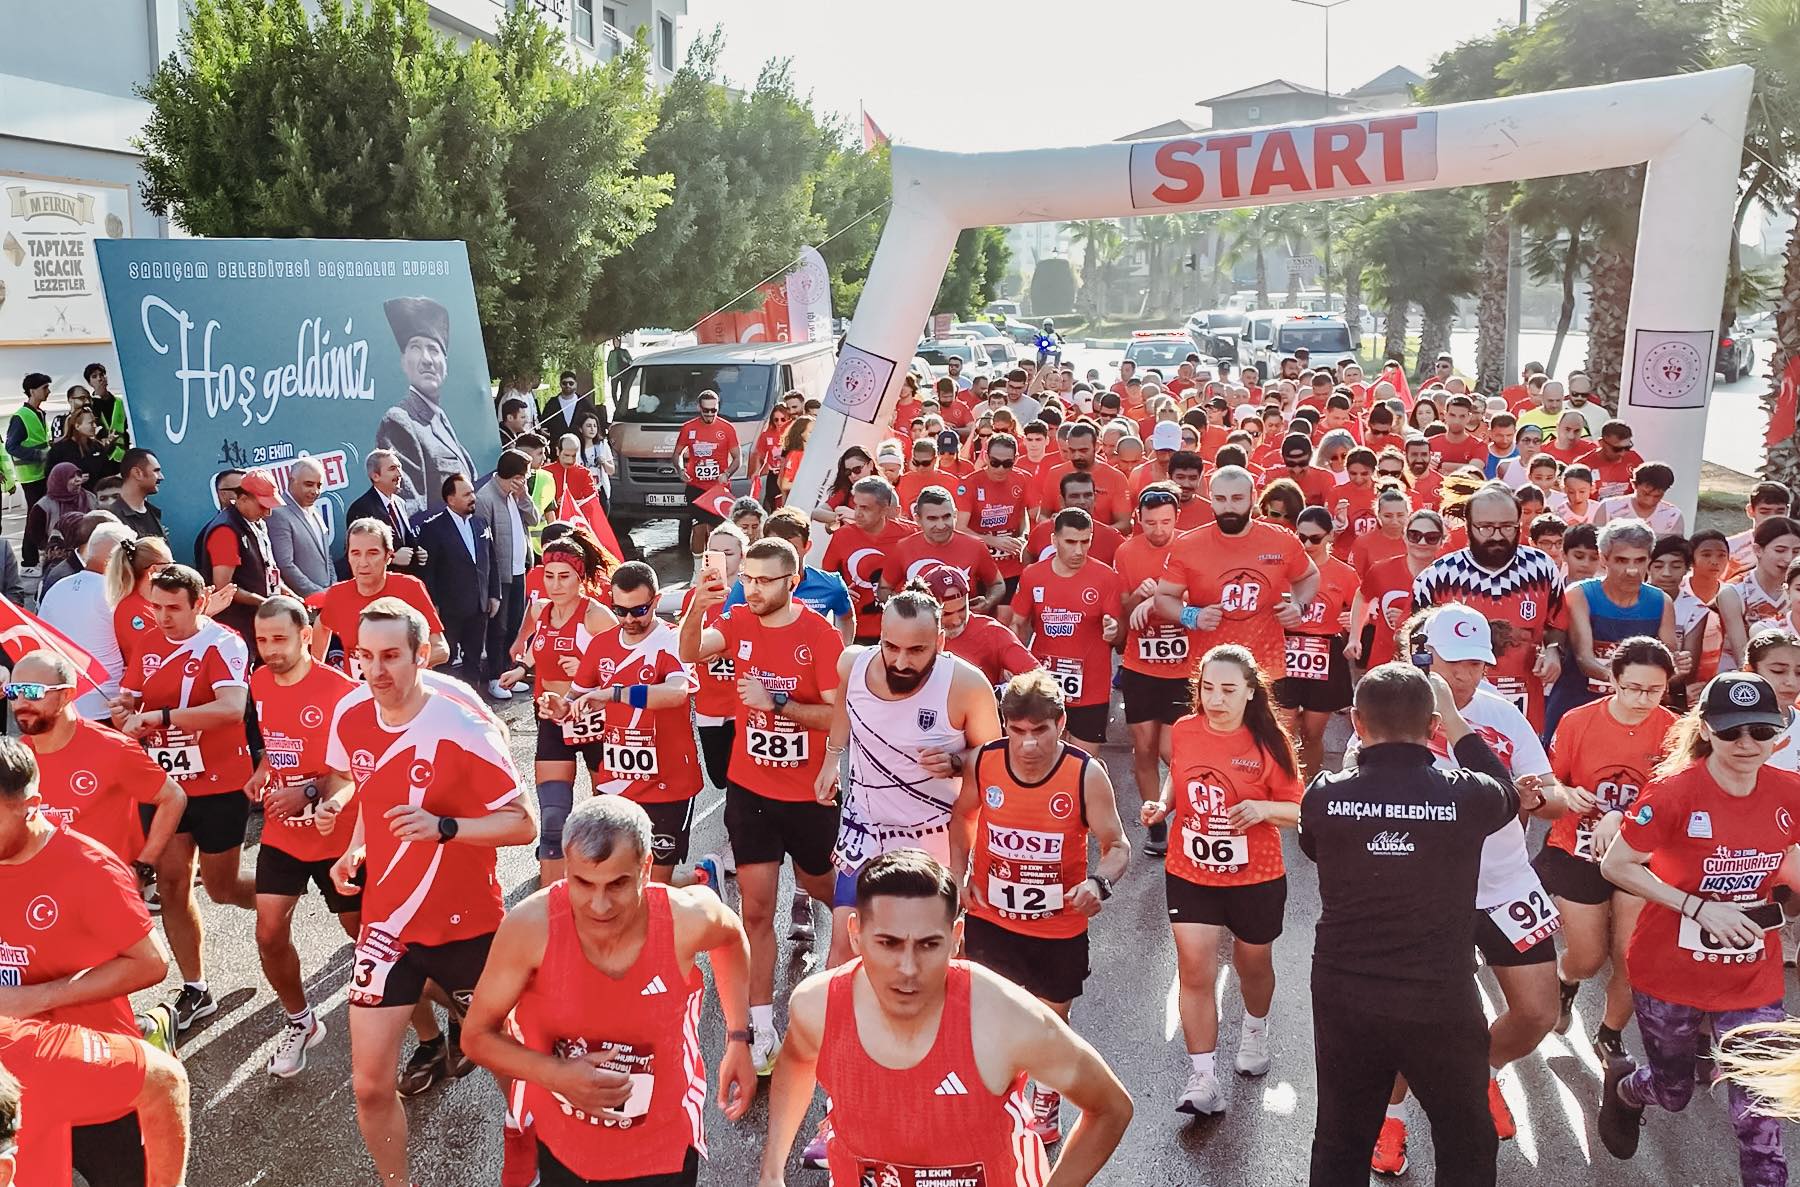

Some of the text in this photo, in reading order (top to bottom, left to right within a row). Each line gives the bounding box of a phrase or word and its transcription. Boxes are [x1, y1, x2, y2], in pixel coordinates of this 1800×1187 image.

[1152, 116, 1418, 204] START
[42, 196, 76, 217] FIRIN
[27, 239, 85, 257] TAPTAZE
[33, 259, 84, 277] SICACIK
[128, 258, 450, 282] SARIÇAM BELEDİYESİ BAŞKANLIK KUPASI
[34, 278, 86, 292] LEZZETLER
[141, 295, 375, 444] Hoş geldiniz
[253, 440, 294, 463] 29 EKİM
[697, 466, 719, 477] 292
[649, 495, 657, 503] 01
[1140, 639, 1187, 658] 160
[1285, 652, 1327, 672] 209
[573, 712, 605, 736] 55
[751, 731, 804, 758] 281
[157, 749, 191, 773] 64
[605, 747, 654, 771] 100
[1327, 800, 1457, 821] SARIÇAM BELEDİYESİ
[1191, 836, 1234, 863] 06
[1705, 852, 1781, 873] CUMHURİYET
[1001, 885, 1046, 910] 12
[1508, 891, 1551, 930] 92
